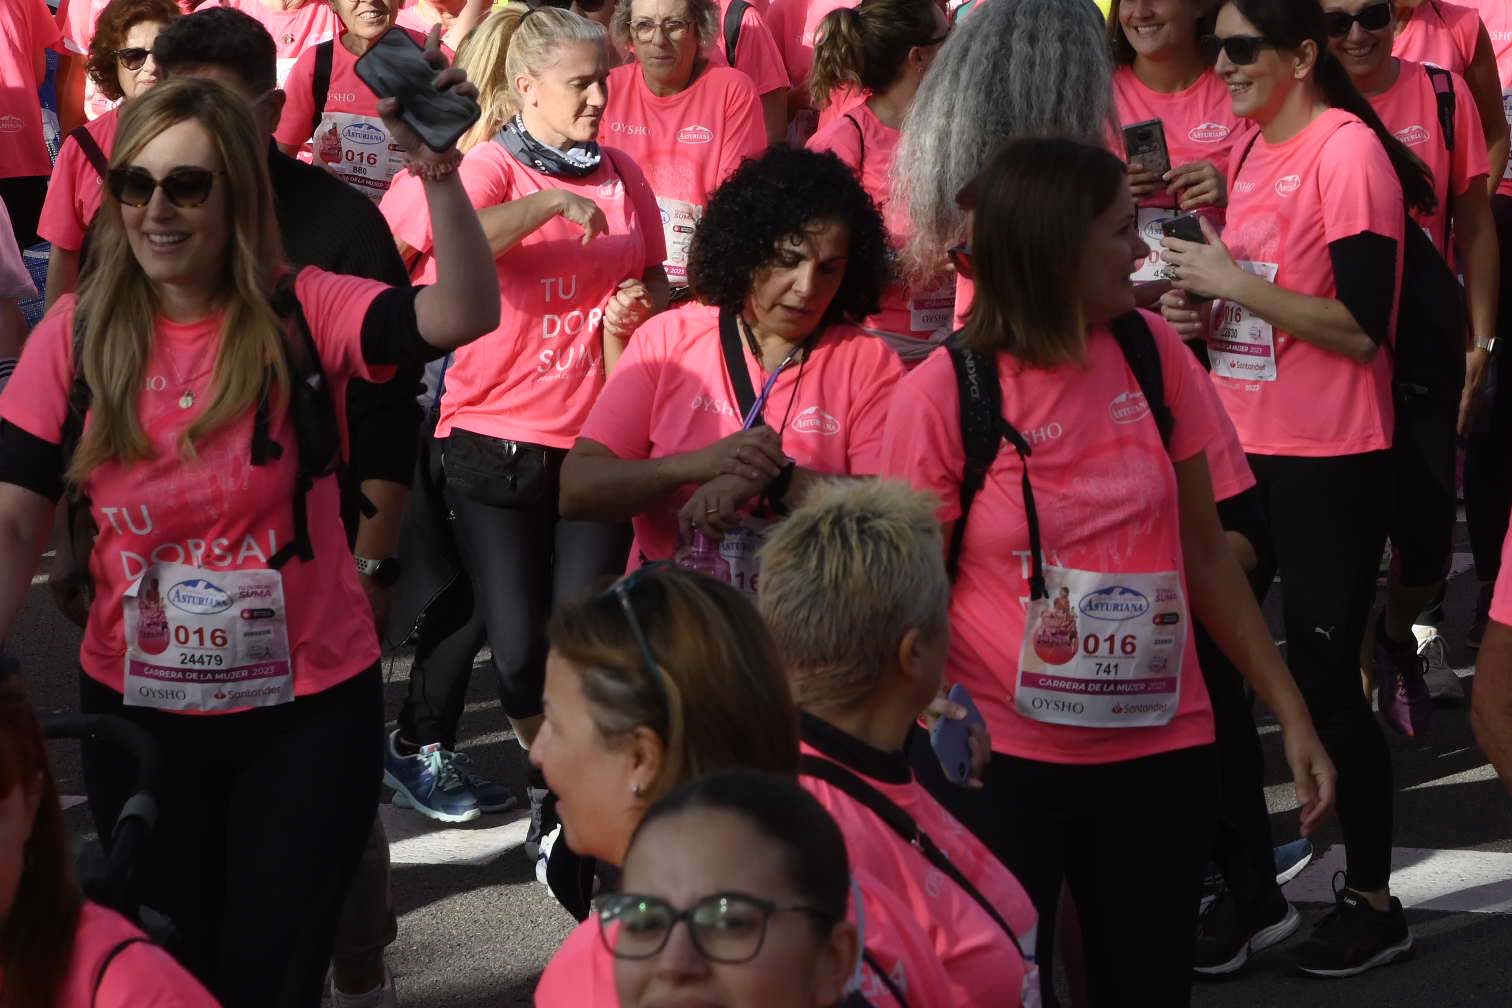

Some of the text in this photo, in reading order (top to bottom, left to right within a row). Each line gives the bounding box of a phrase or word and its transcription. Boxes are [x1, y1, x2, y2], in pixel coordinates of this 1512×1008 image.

[345, 149, 378, 166] 016
[540, 274, 577, 303] TU
[691, 396, 735, 418] OYSH
[101, 503, 154, 536] TU
[171, 588, 229, 608] ASTURIANA
[238, 589, 273, 599] SUMA
[1082, 597, 1146, 614] ASTURIANA
[174, 624, 228, 649] 016
[1083, 634, 1137, 656] 016
[179, 652, 223, 667] 24479
[143, 667, 184, 680] CARRERA
[185, 670, 199, 681] DE
[200, 671, 213, 681] LA
[215, 669, 248, 681] MUJER
[1094, 662, 1119, 676] 741
[139, 685, 187, 701] OYSHO
[227, 684, 281, 700] Santander
[1038, 678, 1086, 691] CARRERA
[1087, 681, 1102, 692] DE
[1103, 681, 1116, 692] LA
[1116, 682, 1146, 693] MUJER
[1031, 696, 1085, 714] OYSHO
[1122, 702, 1168, 715] Santander
